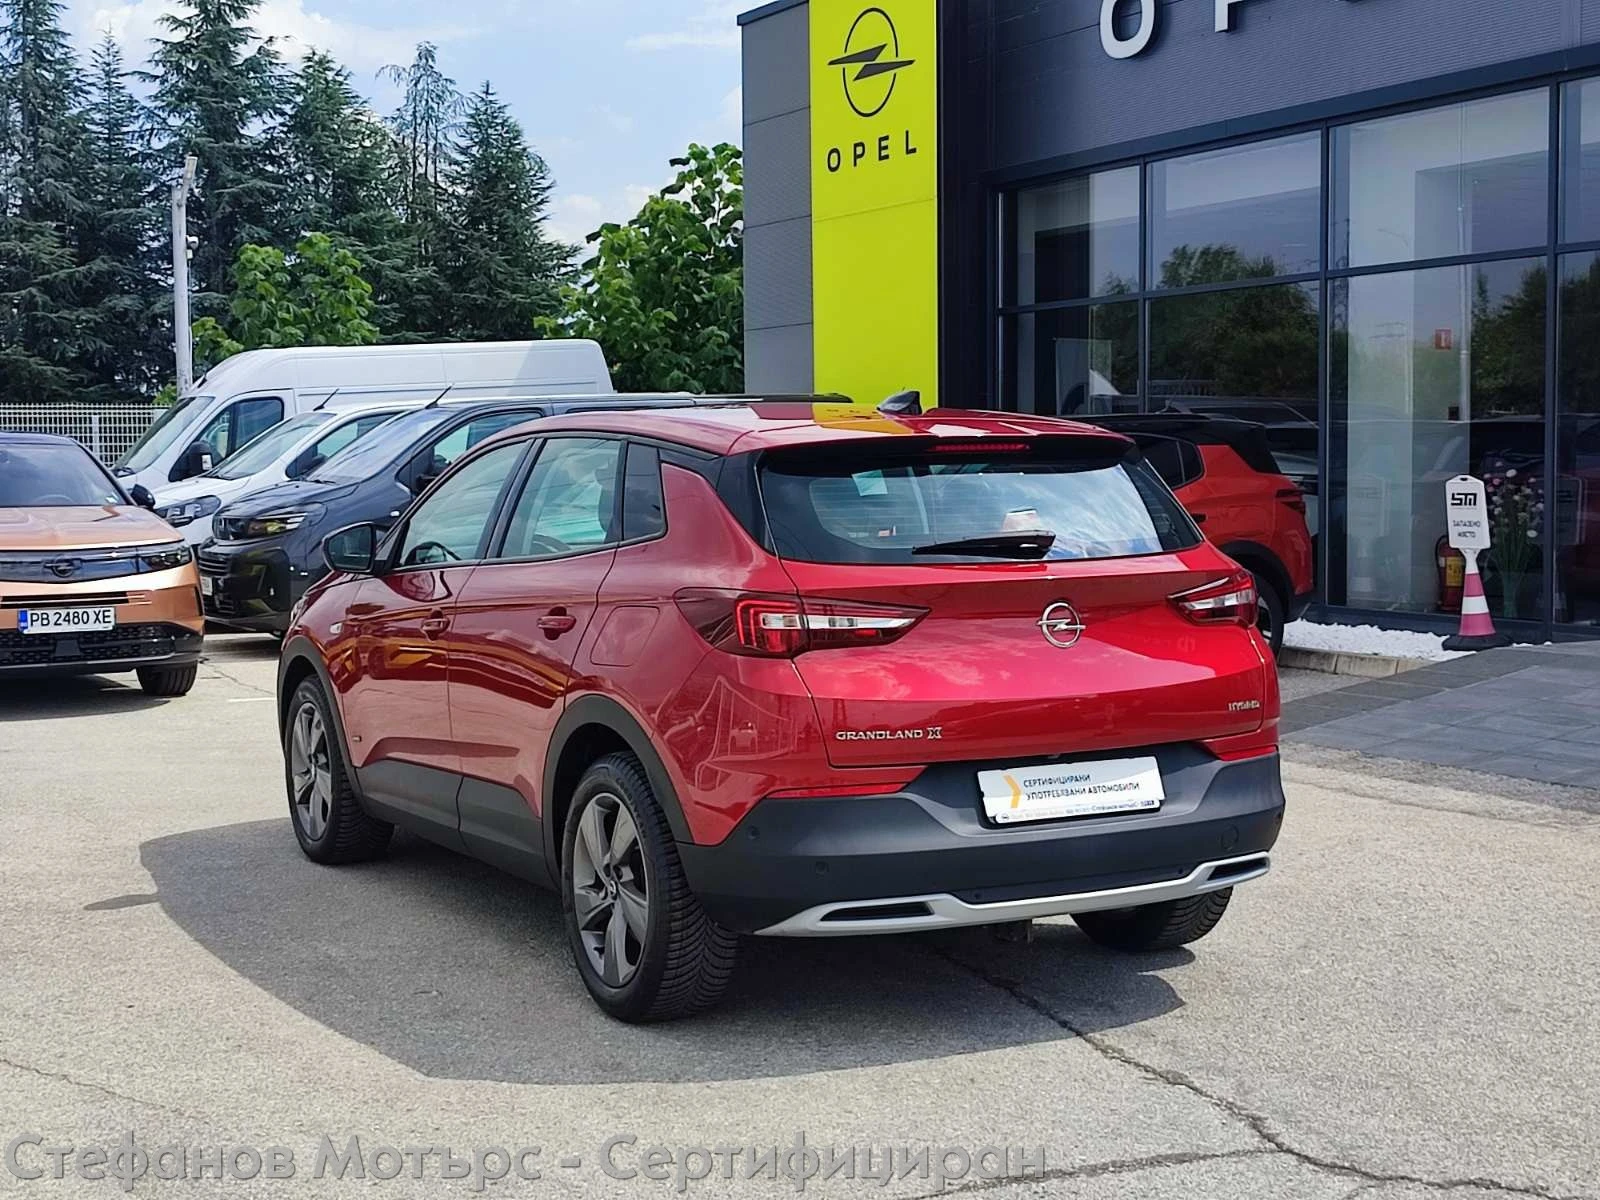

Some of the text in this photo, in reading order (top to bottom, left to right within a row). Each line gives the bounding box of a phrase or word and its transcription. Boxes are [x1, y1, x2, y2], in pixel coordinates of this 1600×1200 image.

[827, 129, 917, 173] OPEL
[30, 612, 51, 627] PB
[53, 610, 90, 626] 2480
[93, 608, 112, 624] XE
[836, 726, 943, 741] GRANDLAND X
[1023, 773, 1092, 788] СЕРТИФИЦИРАНИ
[1026, 781, 1141, 801] УПОТРЕБЯВАНИ АВТОМОБИЛИ
